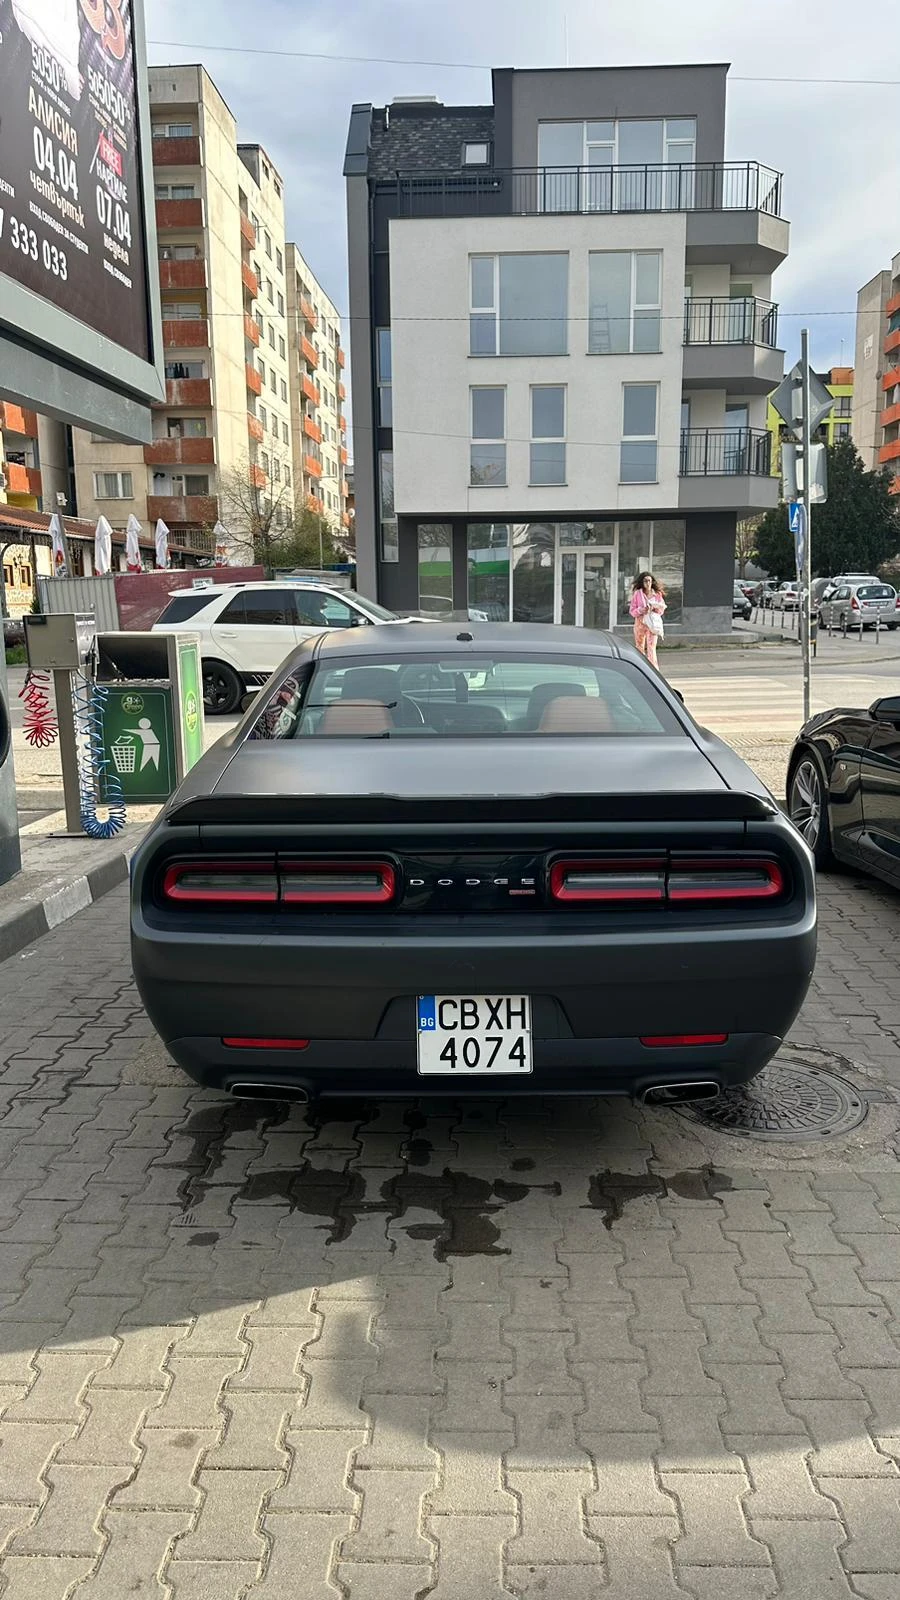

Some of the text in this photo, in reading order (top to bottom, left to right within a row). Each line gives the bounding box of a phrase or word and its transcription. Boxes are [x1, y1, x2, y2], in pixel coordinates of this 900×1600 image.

[29, 85, 78, 156] АЛИСИЯ
[33, 125, 79, 201] 04.04
[29, 170, 85, 228] четвъртък
[96, 184, 132, 249] 07.04
[10, 215, 39, 261] 333
[43, 239, 68, 281] 033
[420, 1017, 434, 1027] BG
[440, 1036, 526, 1068] 4074
